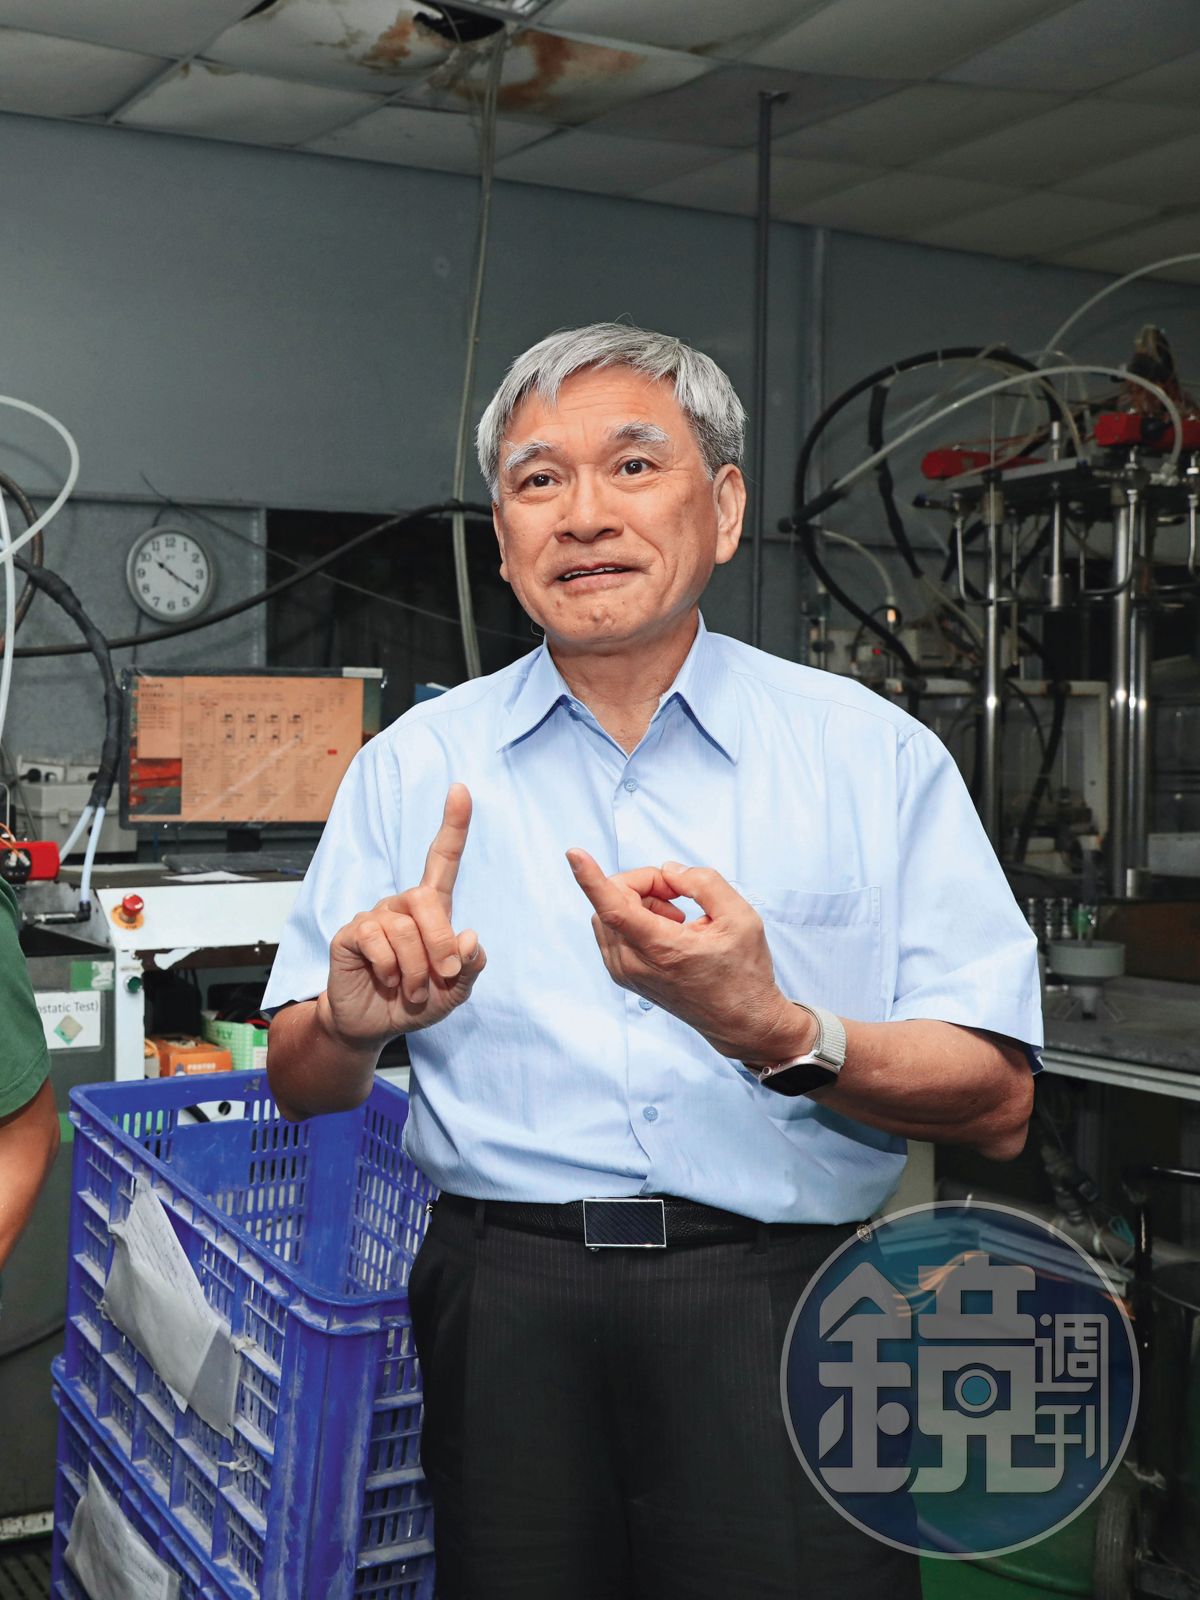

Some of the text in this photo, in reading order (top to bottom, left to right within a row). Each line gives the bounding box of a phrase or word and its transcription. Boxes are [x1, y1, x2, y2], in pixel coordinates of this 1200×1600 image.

[151, 541, 160, 551] 11
[165, 537, 176, 548] 12
[183, 541, 188, 552] 1
[141, 552, 152, 562] 10
[192, 553, 200, 563] 2
[137, 568, 146, 578] 9
[195, 569, 204, 579] 3
[142, 584, 150, 593] 8
[152, 597, 160, 607] 7
[167, 600, 176, 610] 6
[182, 597, 190, 607] 5
[74, 1000, 99, 1013] Test)
